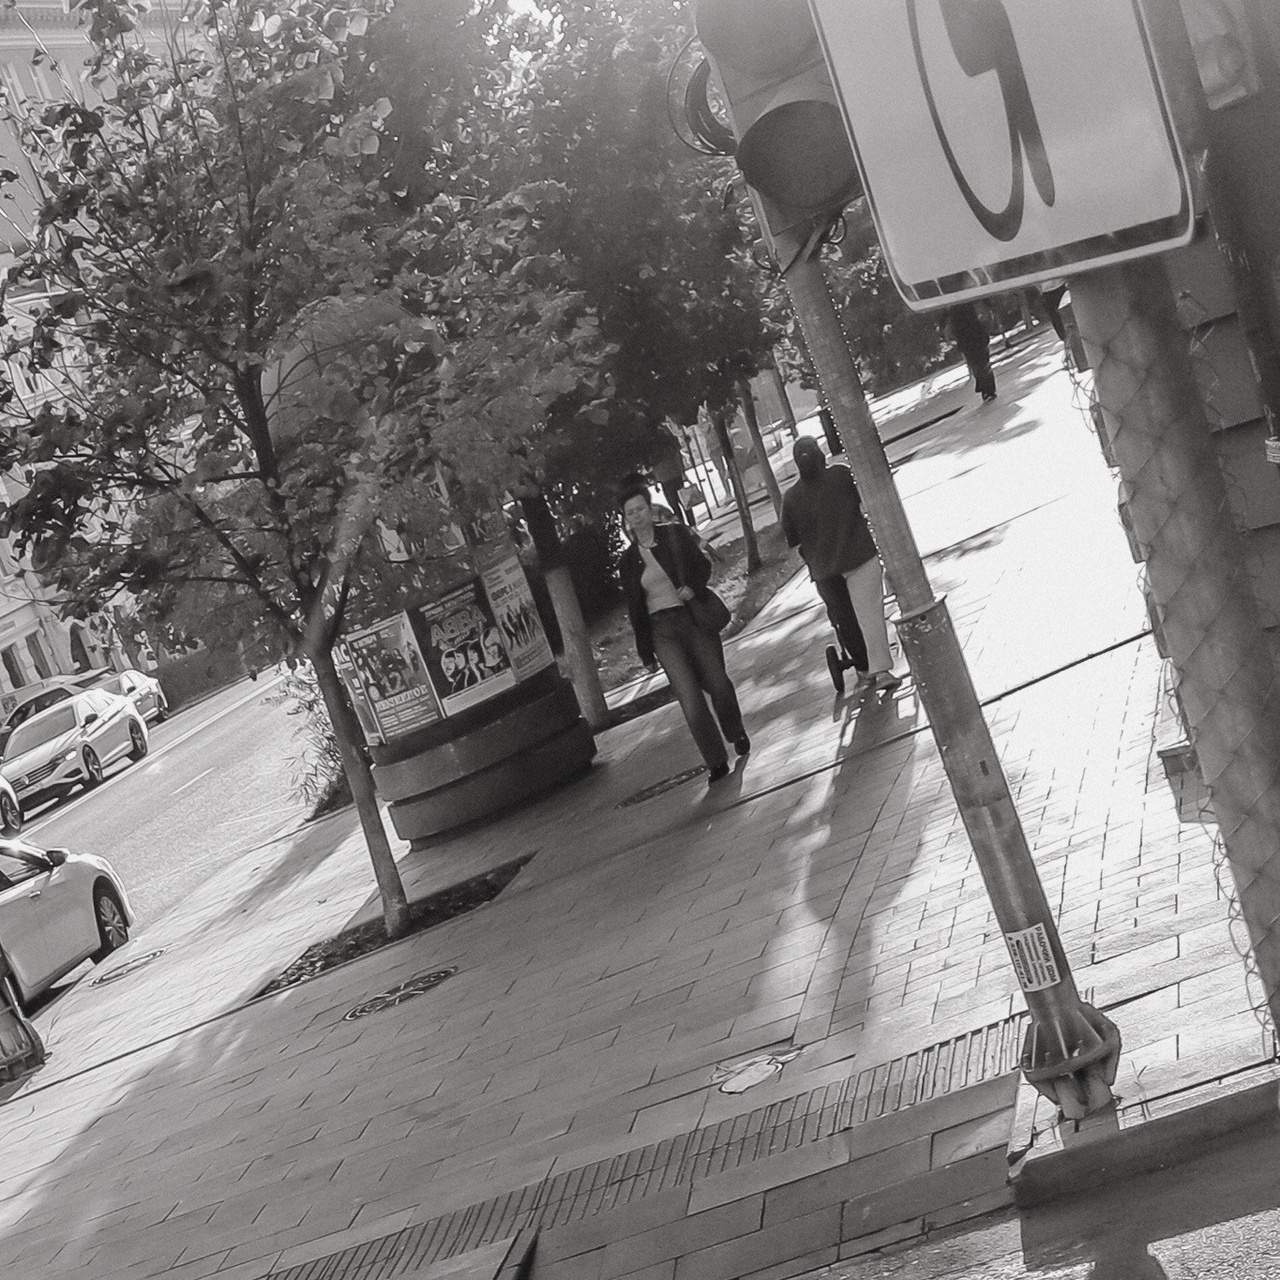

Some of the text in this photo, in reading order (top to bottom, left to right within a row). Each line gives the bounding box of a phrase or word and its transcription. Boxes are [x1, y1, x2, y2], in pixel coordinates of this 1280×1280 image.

[430, 604, 488, 648] ABBA
[1035, 926, 1052, 964] РАБОЧИЙ
[1045, 964, 1058, 983] ДОМ
